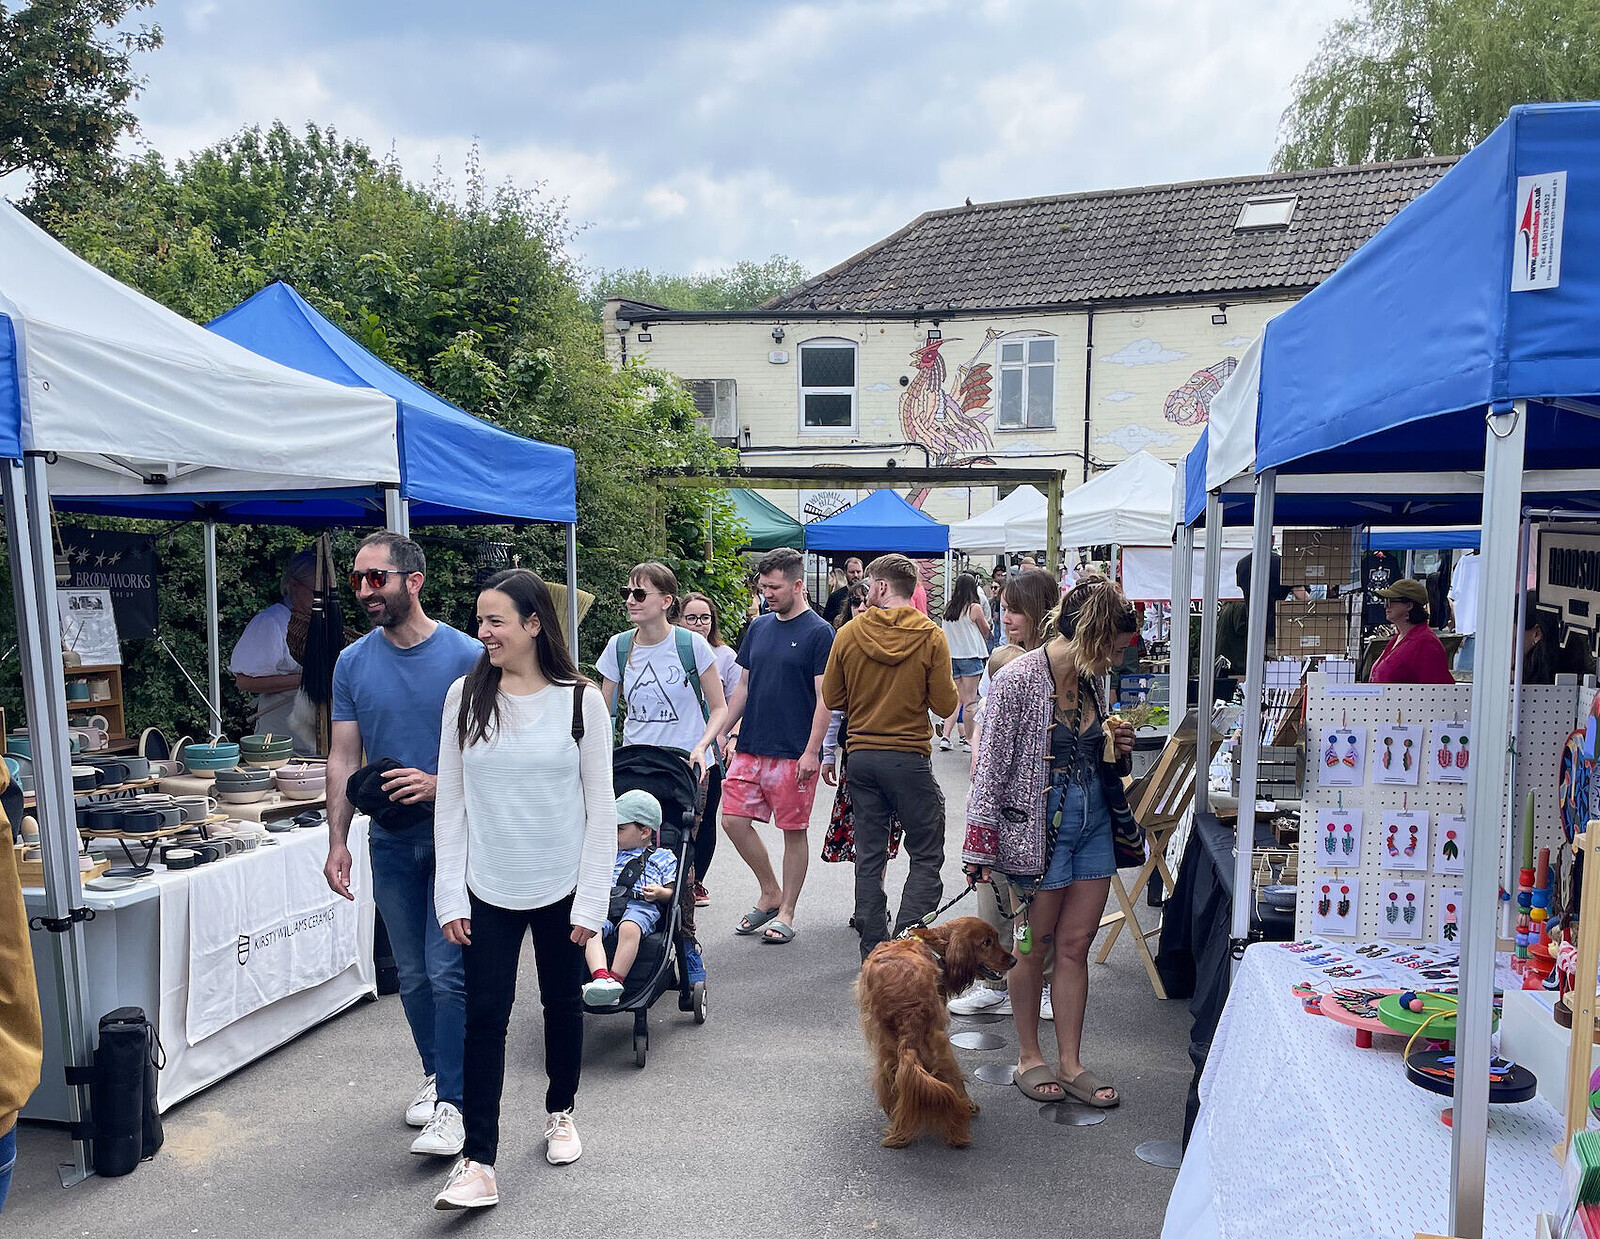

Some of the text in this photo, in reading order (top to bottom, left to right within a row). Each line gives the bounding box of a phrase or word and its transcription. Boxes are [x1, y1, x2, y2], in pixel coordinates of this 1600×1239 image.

[1530, 187, 1541, 281] www.gazeboshop.co.uk
[809, 491, 846, 505] WINDMILL
[818, 498, 837, 508] HILL
[76, 571, 151, 589] BROOMWORKS
[254, 907, 335, 950] KIRSTY WILLIAMS CERAMICS
